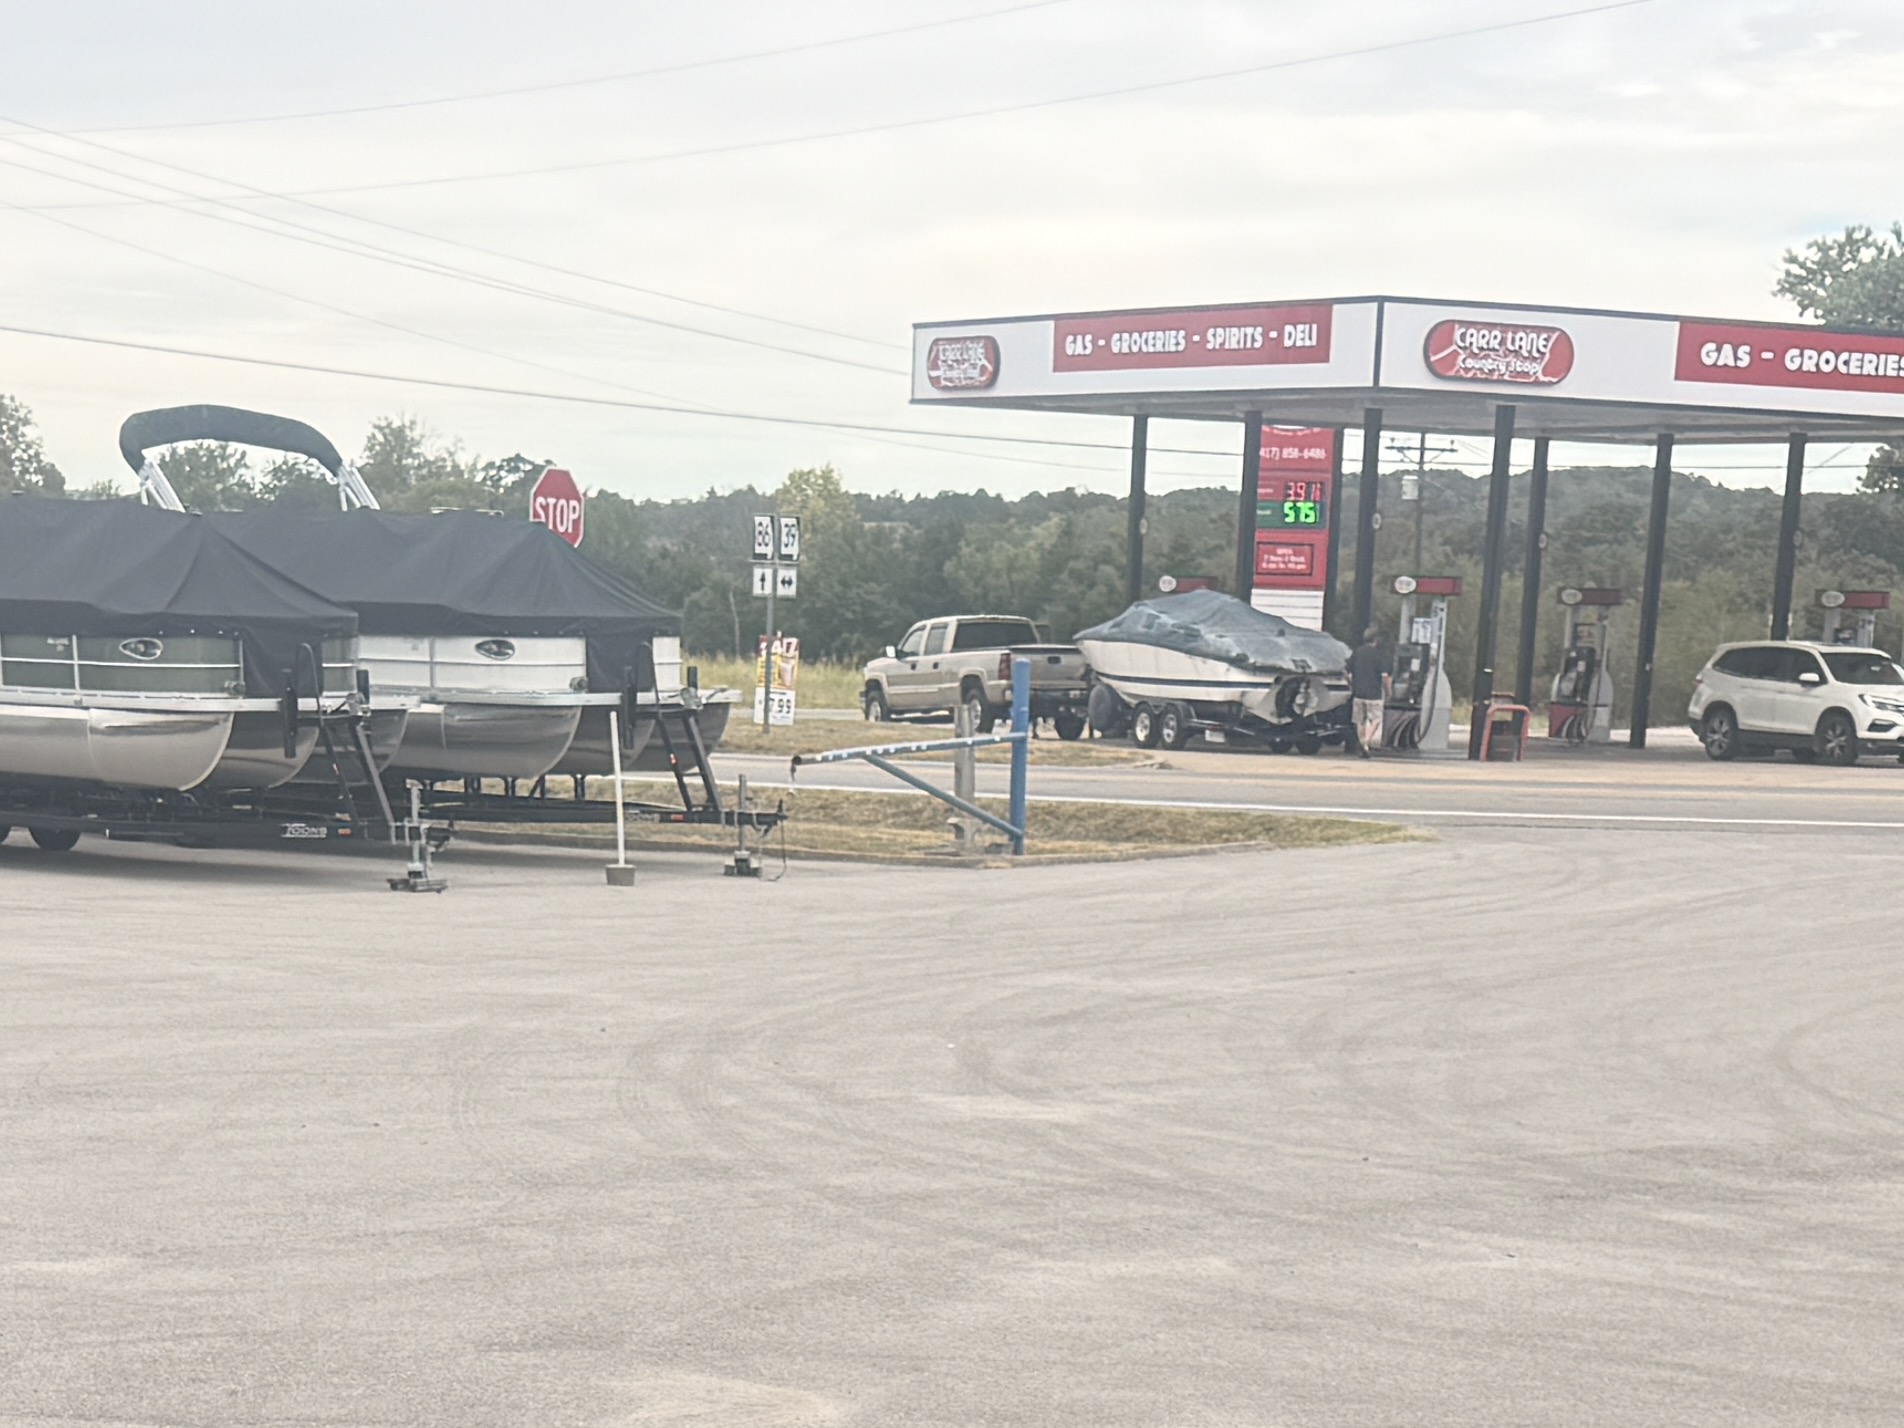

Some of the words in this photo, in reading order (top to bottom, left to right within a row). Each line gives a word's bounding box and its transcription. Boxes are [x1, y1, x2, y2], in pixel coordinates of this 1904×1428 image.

[1065, 333, 1093, 355] GAS
[1110, 330, 1187, 354] GROCERIES
[1206, 326, 1264, 350] SPIRITS
[1283, 323, 1318, 347] DELI
[1456, 327, 1502, 354] CARR
[1506, 331, 1549, 358] LANE
[1458, 355, 1507, 374] Country
[1700, 342, 1751, 368] GAS
[535, 496, 581, 534] STOP
[783, 523, 797, 549] 39
